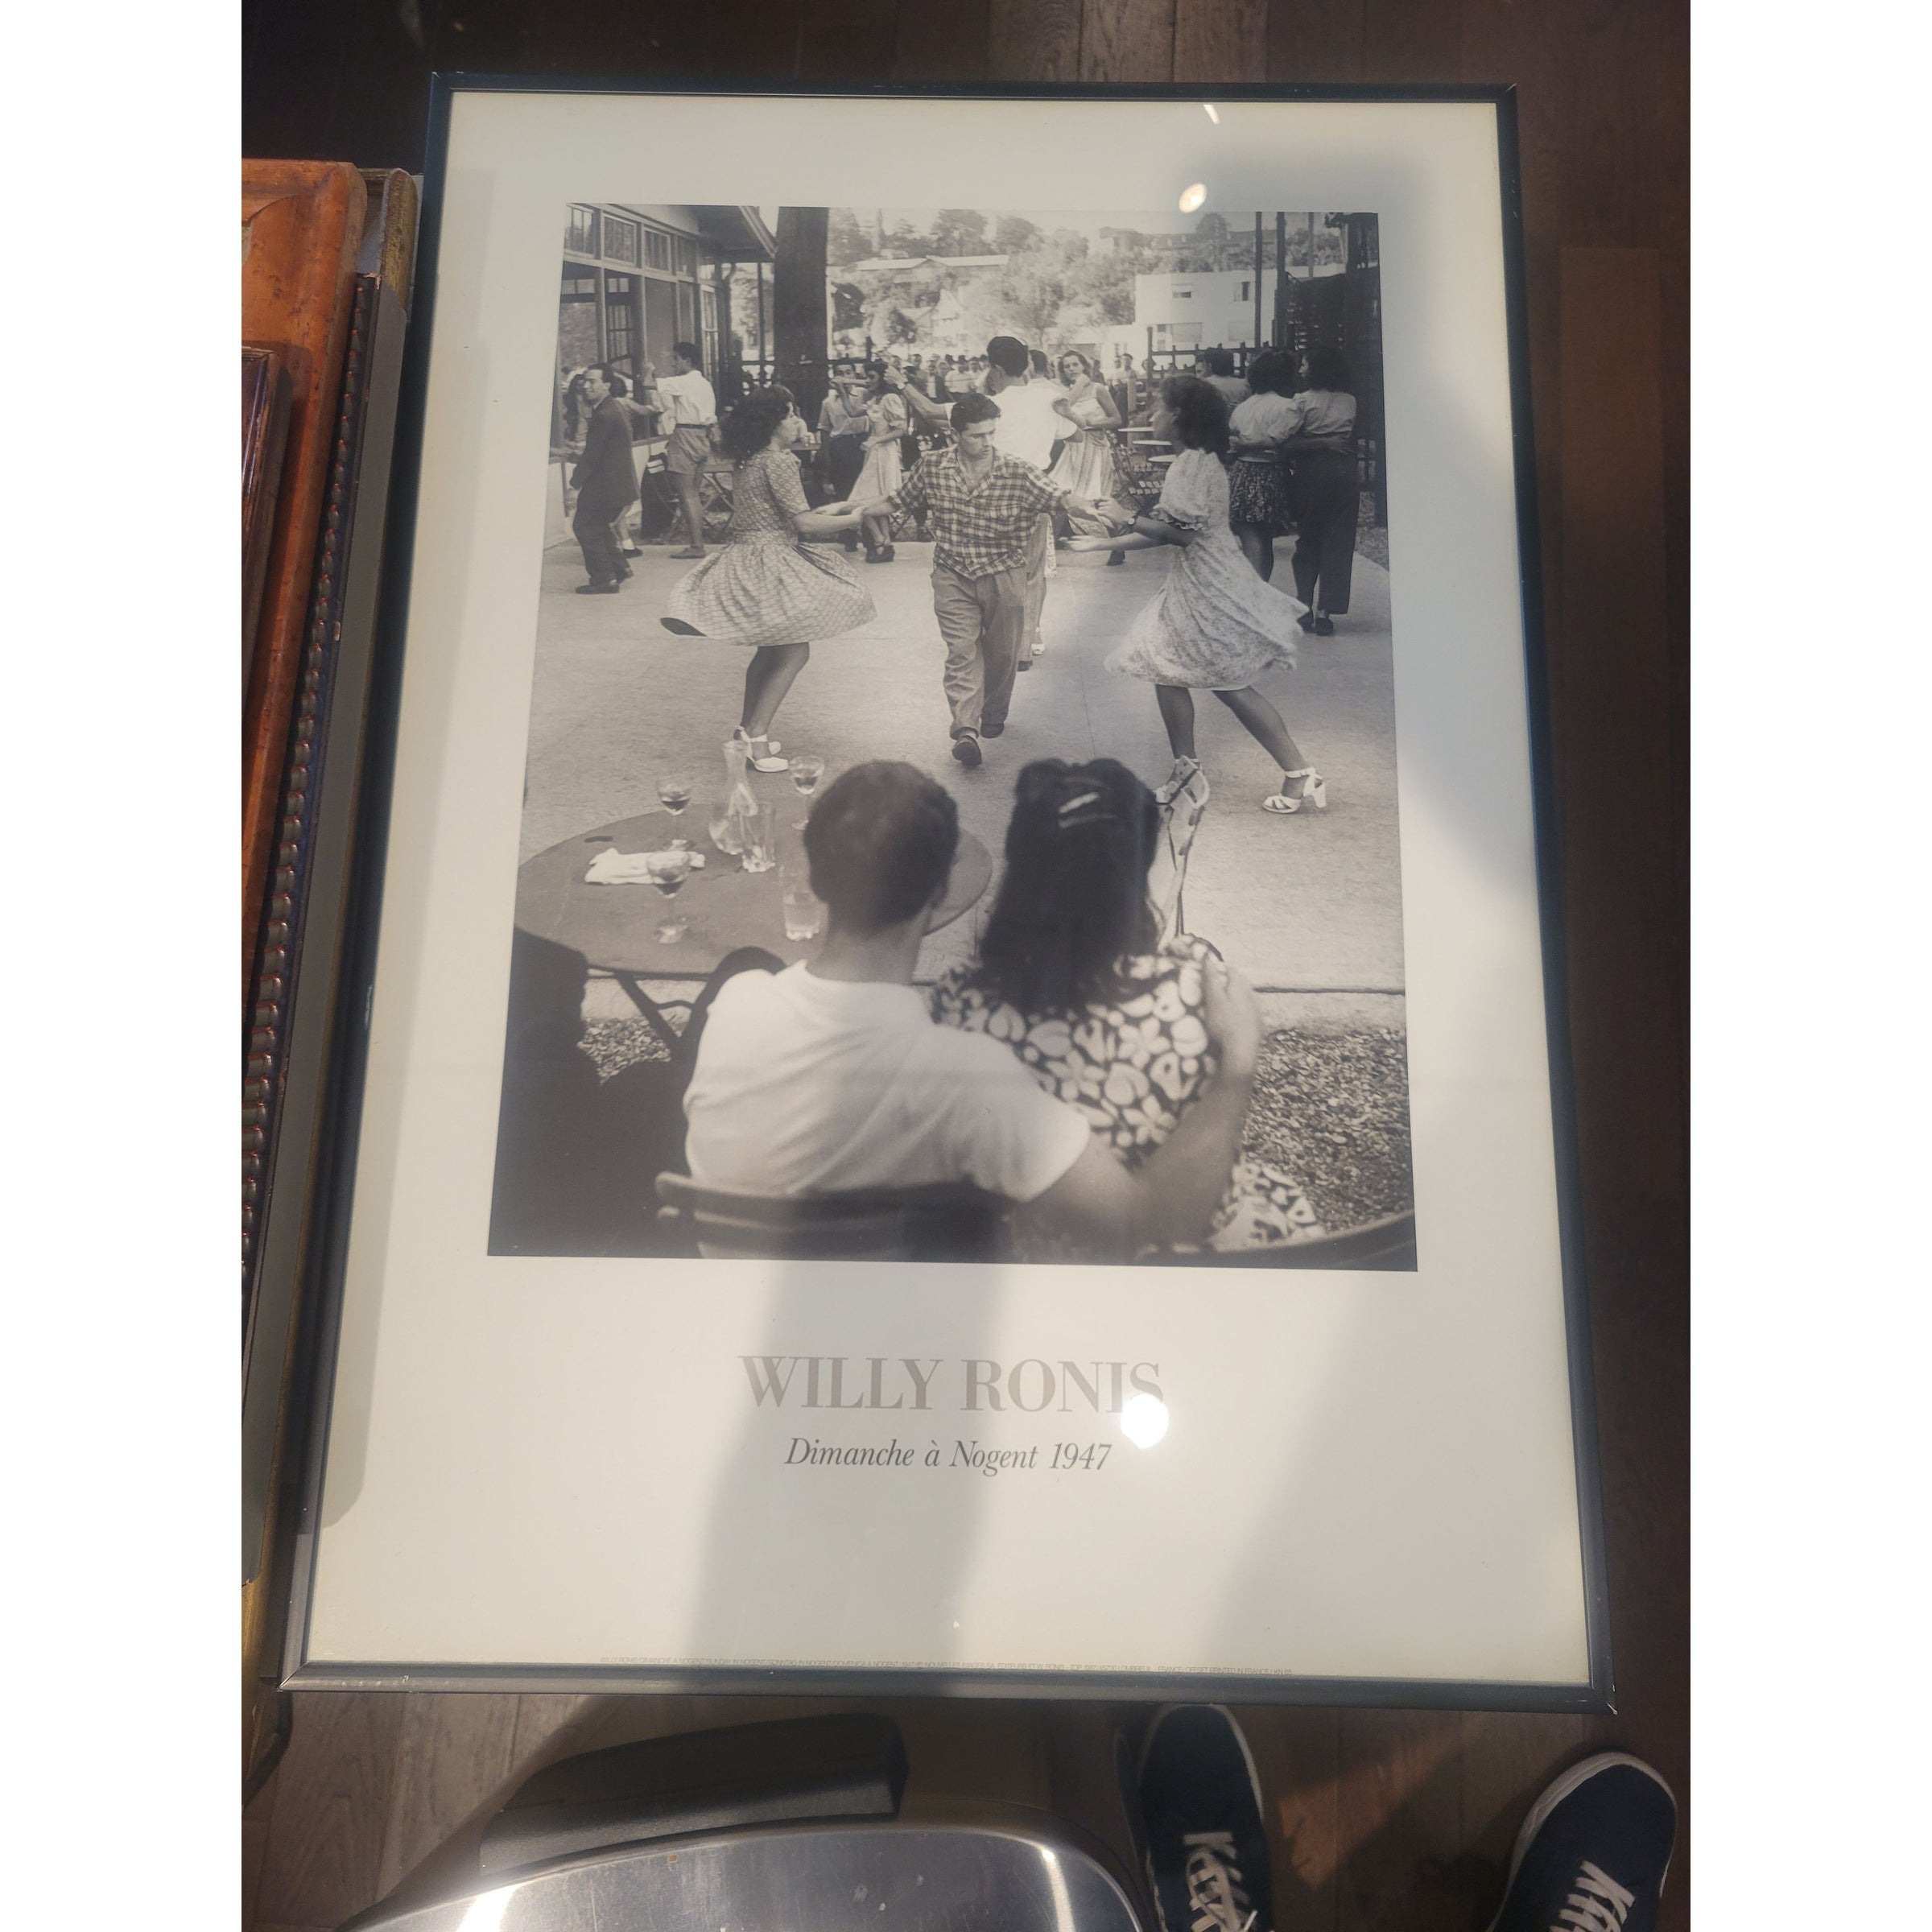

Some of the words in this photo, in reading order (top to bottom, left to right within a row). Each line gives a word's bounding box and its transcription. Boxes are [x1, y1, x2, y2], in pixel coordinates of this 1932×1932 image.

[737, 1355, 944, 1410] WILLY
[783, 1437, 914, 1467] Dimanche
[924, 1439, 939, 1467] à
[949, 1440, 1038, 1477] Nogent
[1048, 1442, 1113, 1472] 1947
